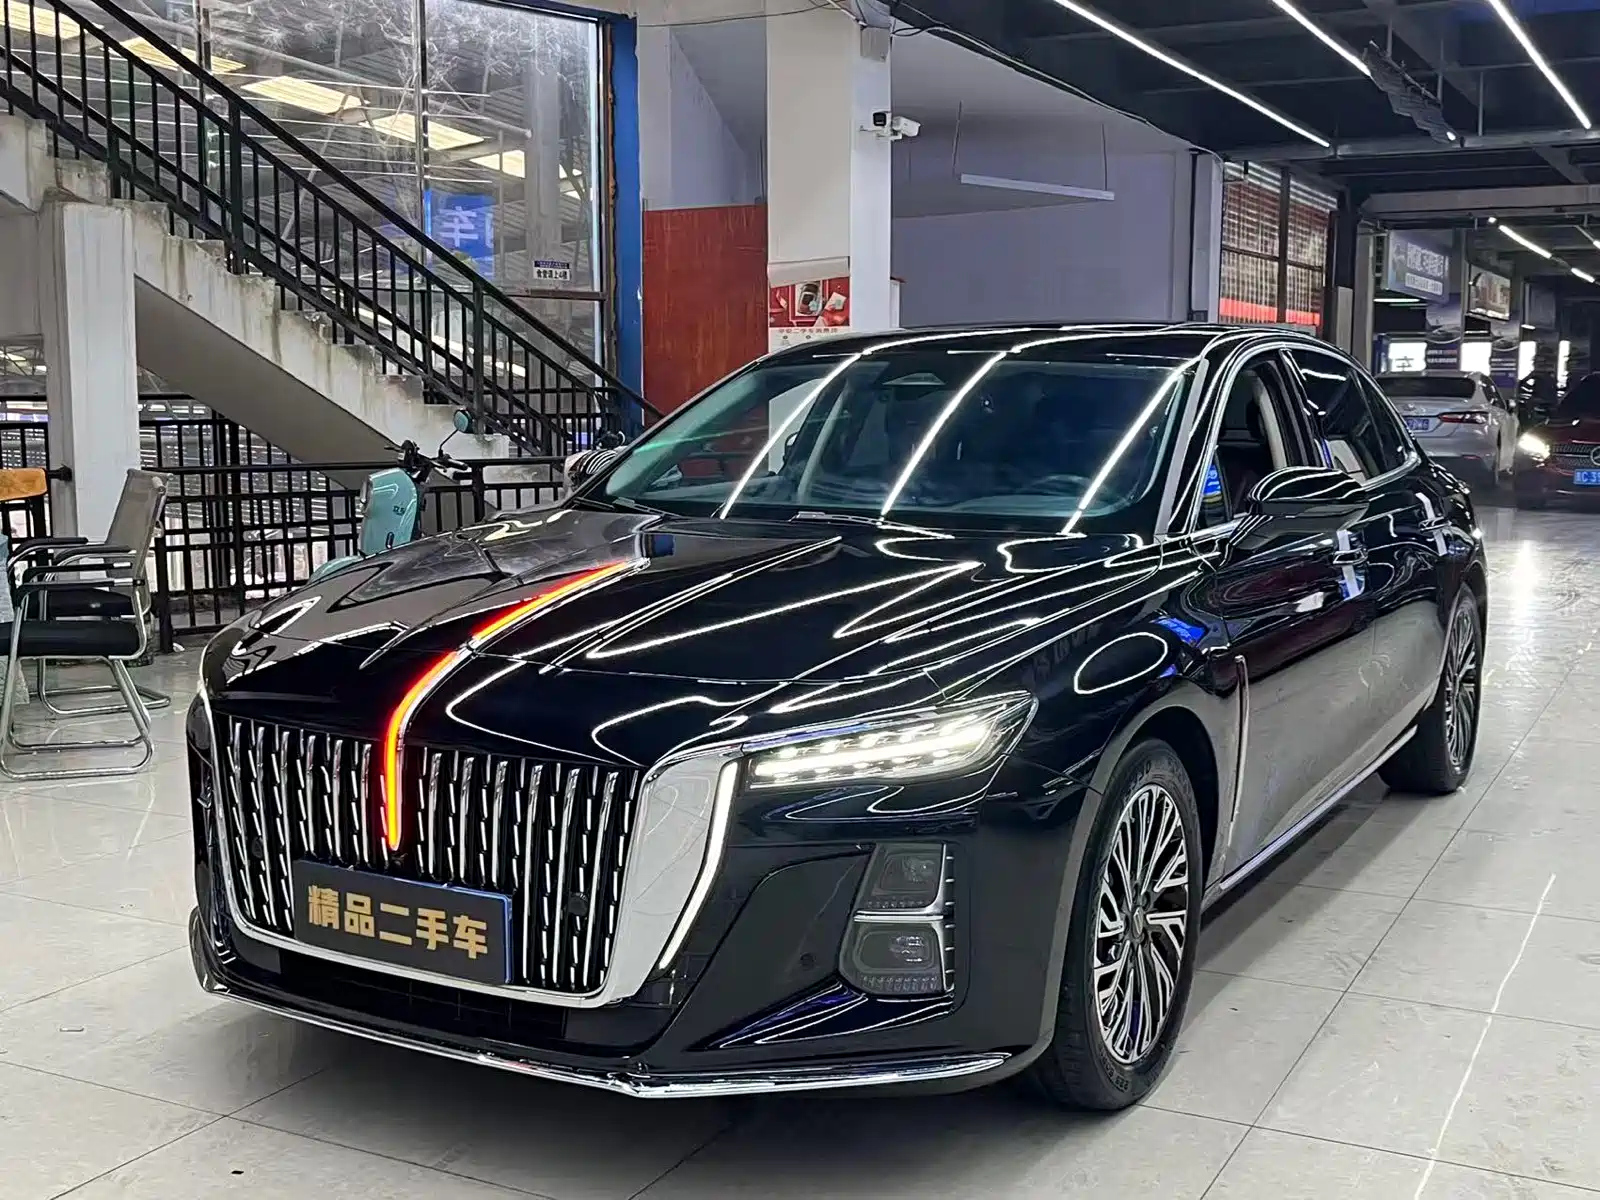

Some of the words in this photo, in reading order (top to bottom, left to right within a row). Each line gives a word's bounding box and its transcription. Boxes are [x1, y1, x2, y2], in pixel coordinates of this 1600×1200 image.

[308, 884, 488, 960] 精品二手车
